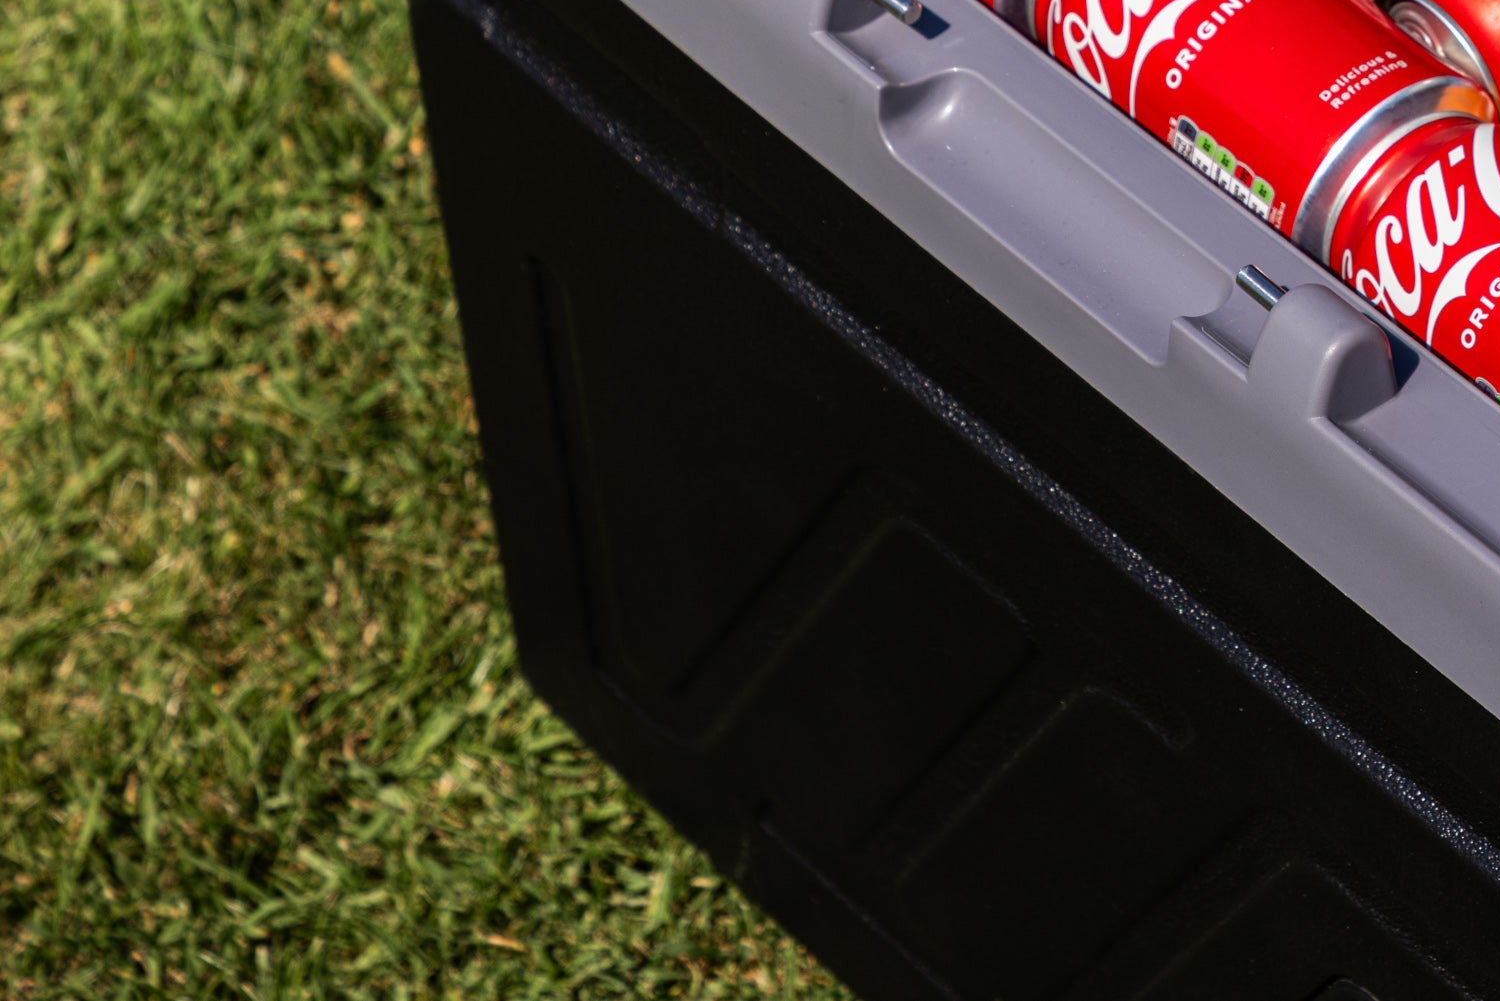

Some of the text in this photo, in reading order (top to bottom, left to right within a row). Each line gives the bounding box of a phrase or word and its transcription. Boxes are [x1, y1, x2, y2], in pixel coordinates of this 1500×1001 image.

[1319, 50, 1398, 102] Delicious &
[1330, 58, 1408, 109] Refreshing
